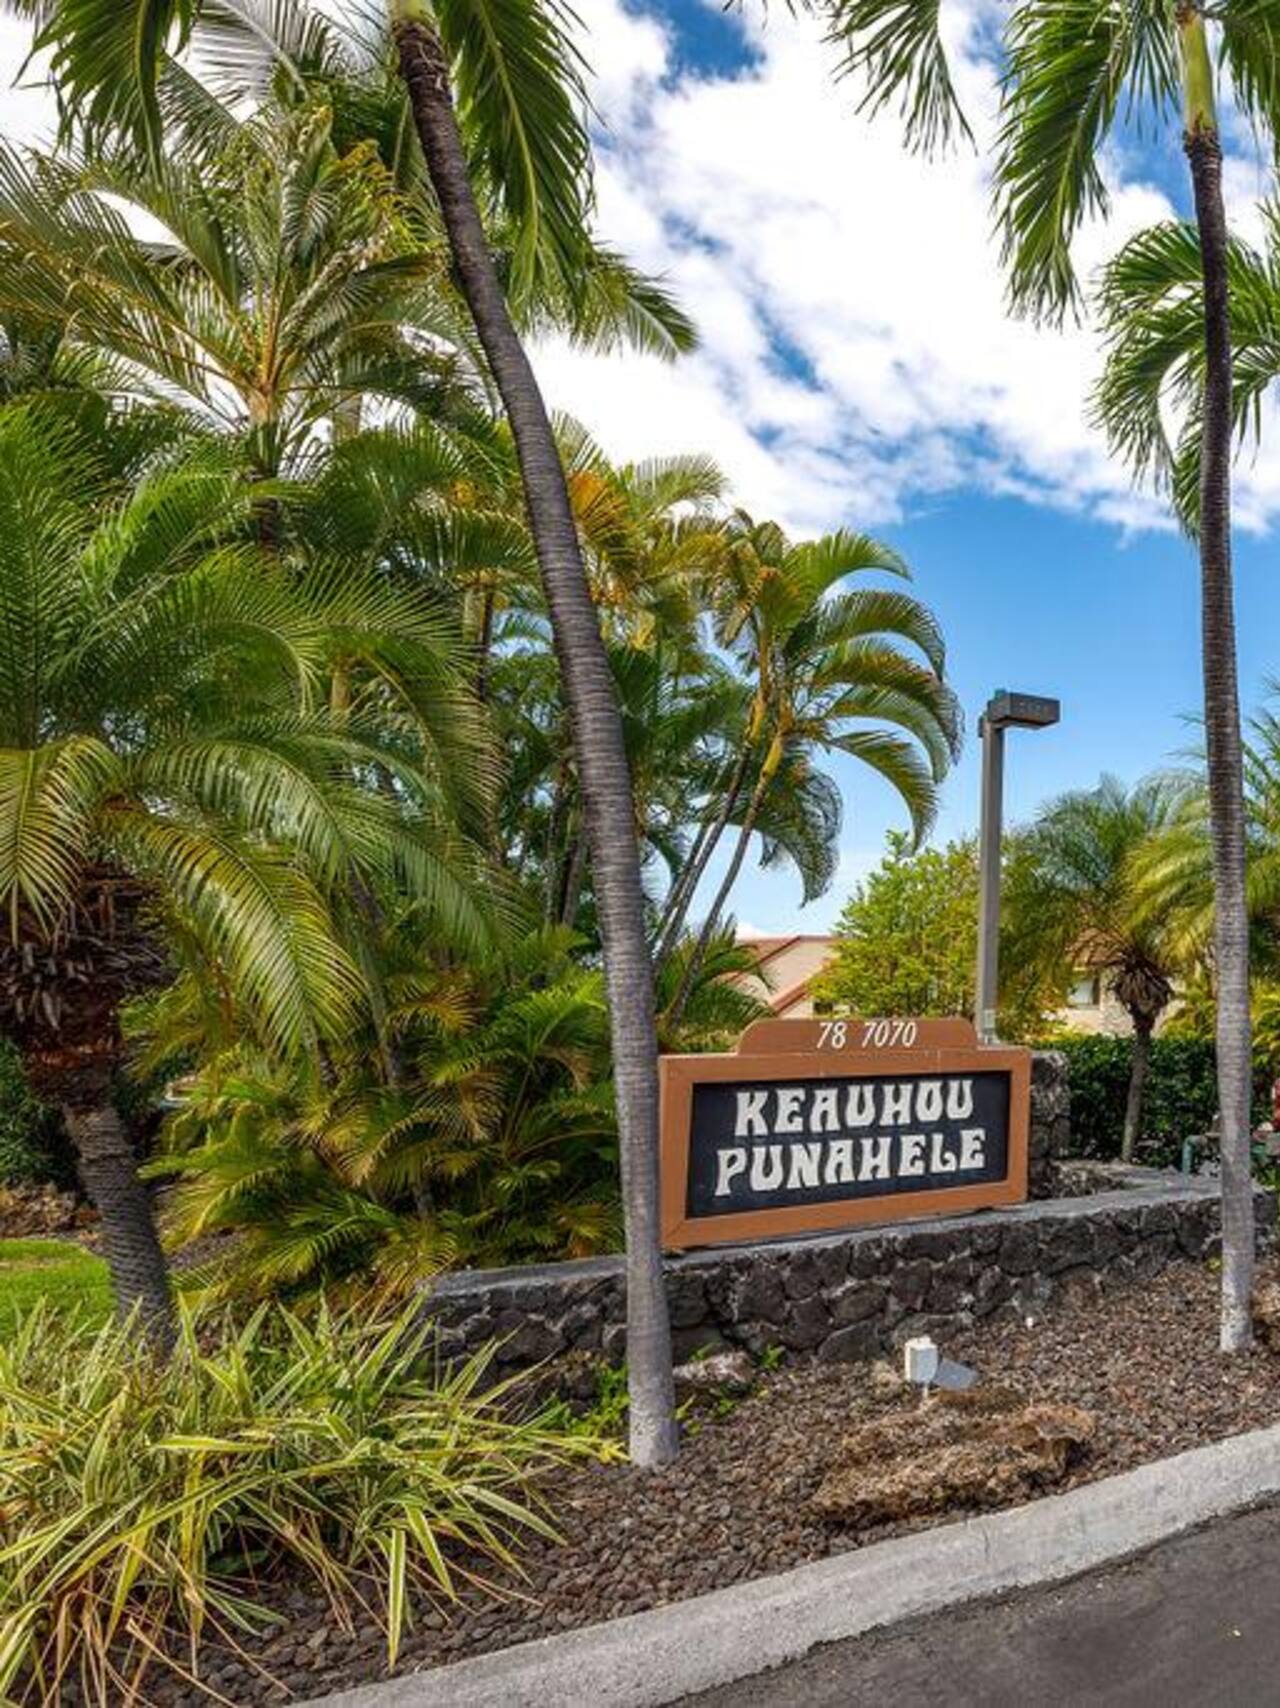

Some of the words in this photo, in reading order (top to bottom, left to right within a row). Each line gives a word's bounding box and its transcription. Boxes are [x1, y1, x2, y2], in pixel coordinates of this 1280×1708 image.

[816, 1022, 847, 1049] 78
[861, 1020, 917, 1048] 7070
[734, 1079, 974, 1137] KEAUHOU
[714, 1128, 987, 1196] PUNAHELE
